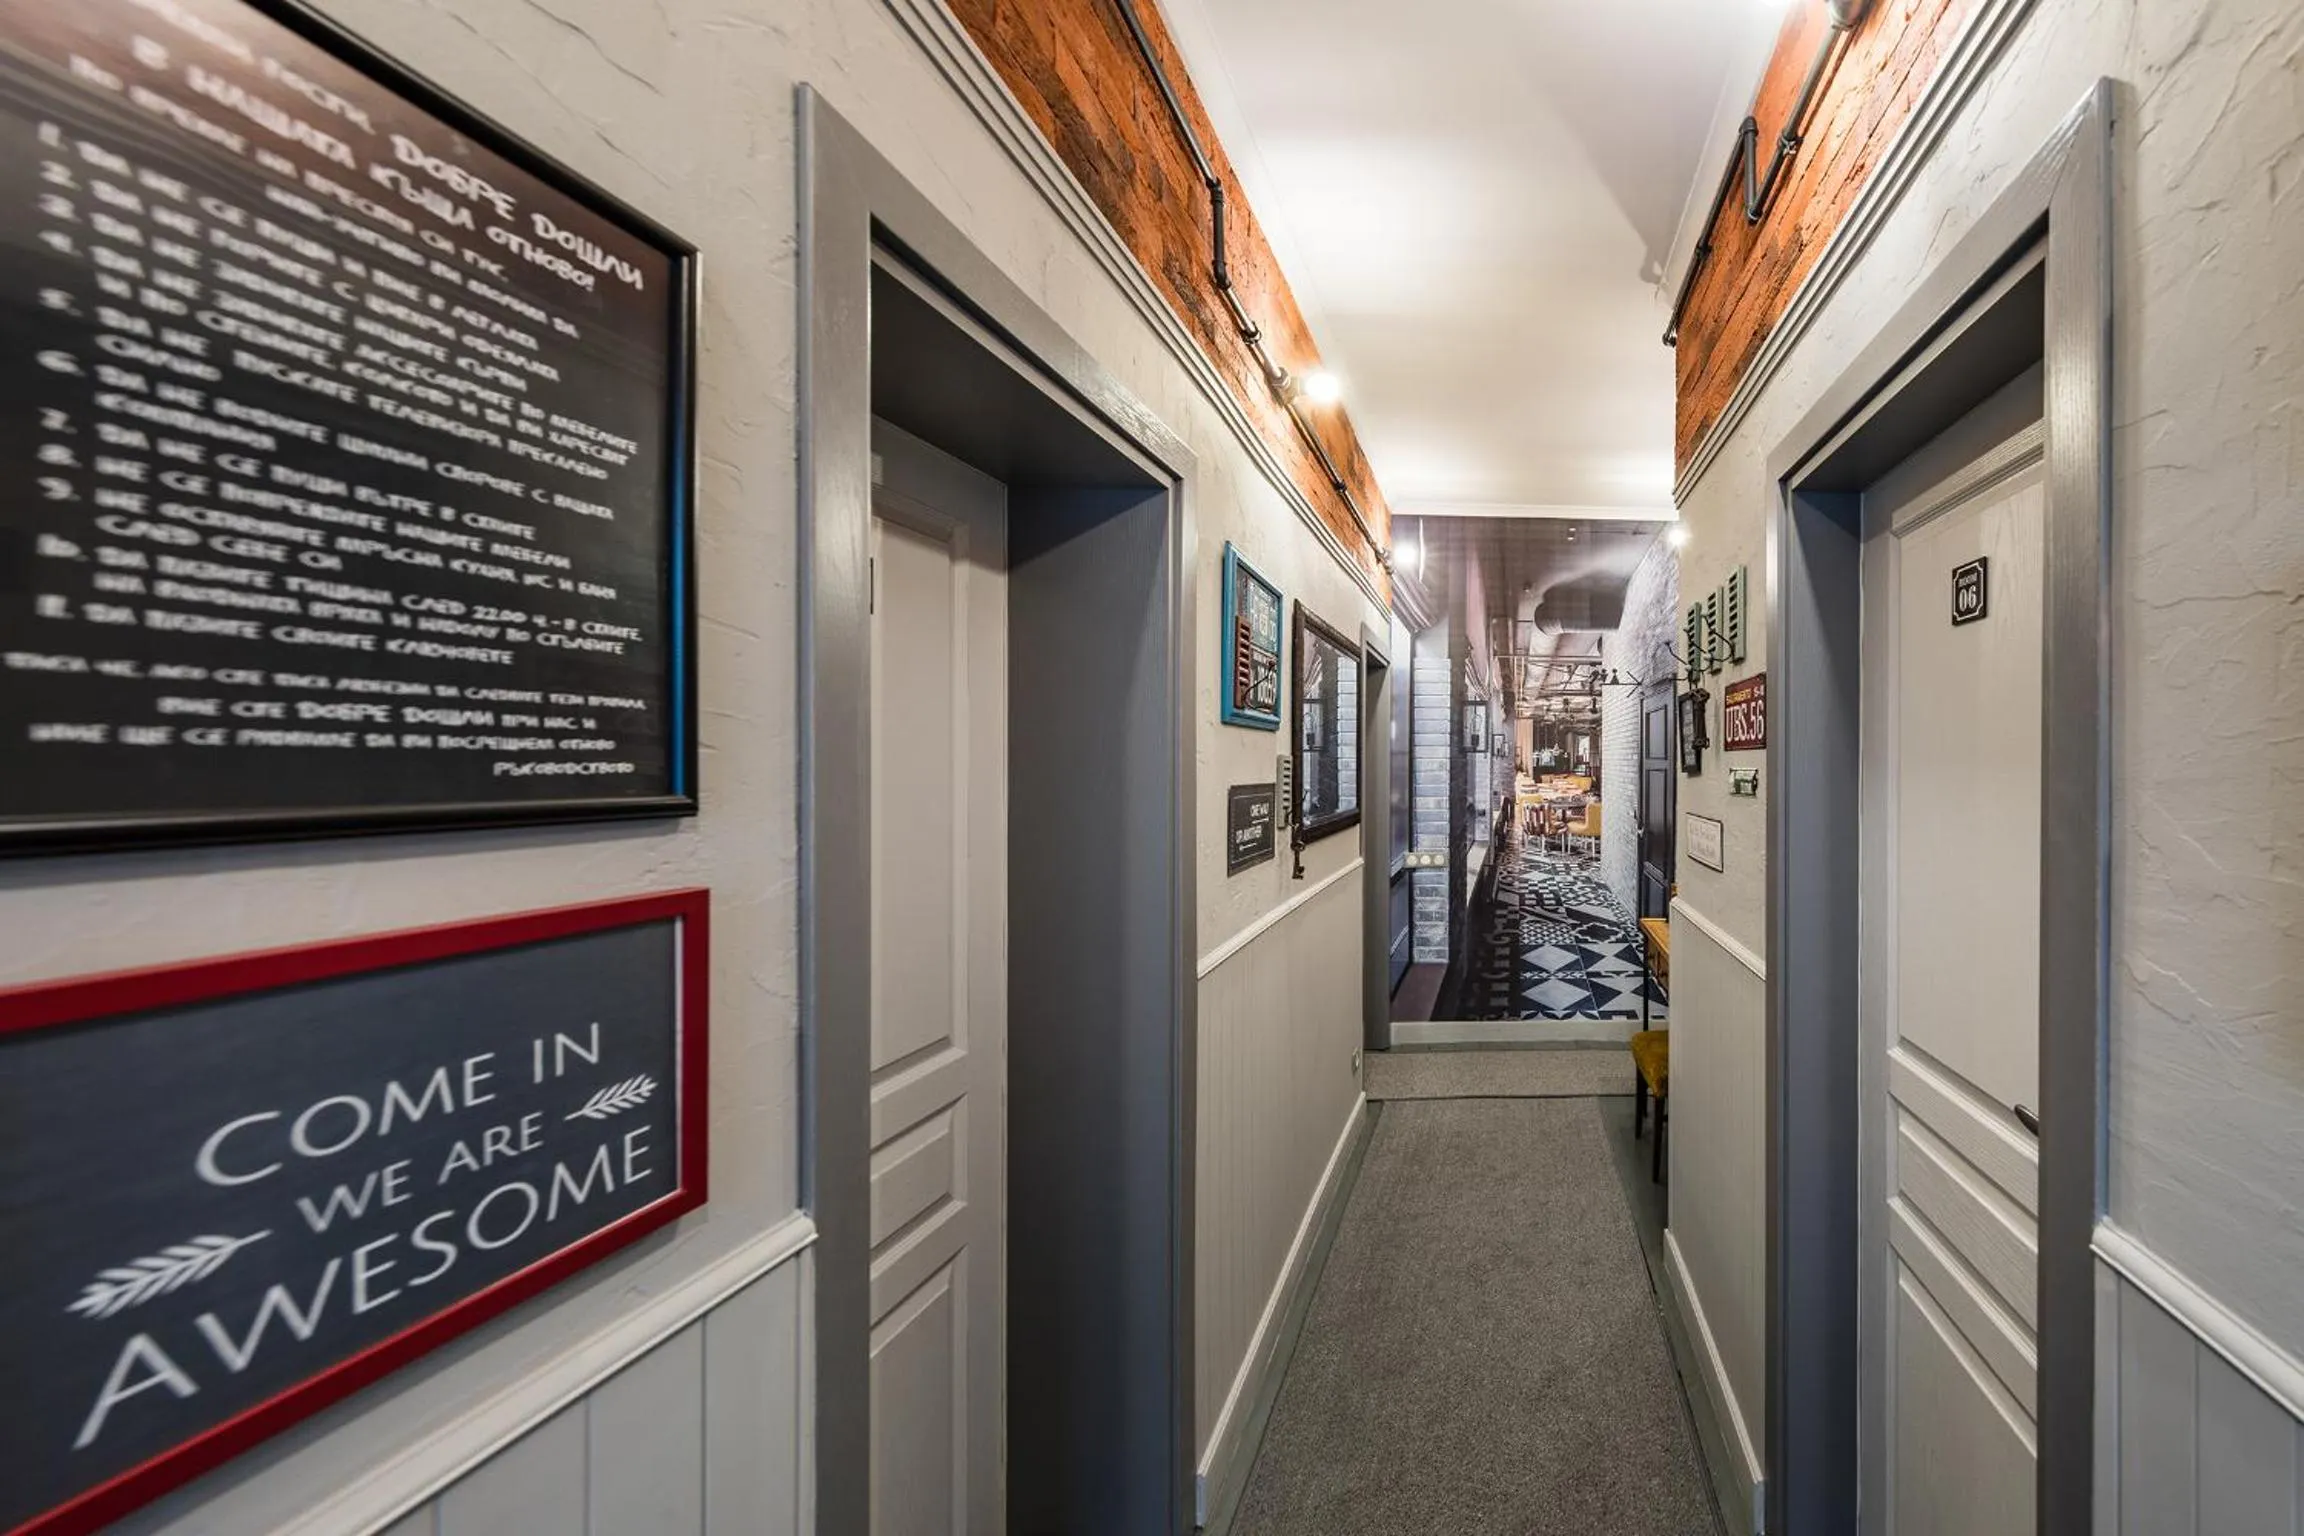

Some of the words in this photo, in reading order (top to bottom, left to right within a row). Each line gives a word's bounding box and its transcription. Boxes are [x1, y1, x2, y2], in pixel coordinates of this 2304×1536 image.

[188, 66, 354, 167] НАШАТА
[370, 164, 474, 229] КЪЩА
[486, 226, 594, 291] ОТНОВО!
[391, 134, 516, 219] ДОБРЕ
[531, 213, 642, 289] ДОШЛИ
[332, 281, 357, 301] С
[530, 488, 548, 503] С
[1959, 585, 1977, 612] 06
[296, 701, 391, 722] ДОБРЕ
[402, 706, 494, 725] ДОШЛИ
[195, 1052, 496, 1185] COME
[532, 1021, 600, 1083] IN
[296, 1159, 412, 1233] WE
[437, 1111, 544, 1184] ARE
[71, 1124, 652, 1450] AWESOME
